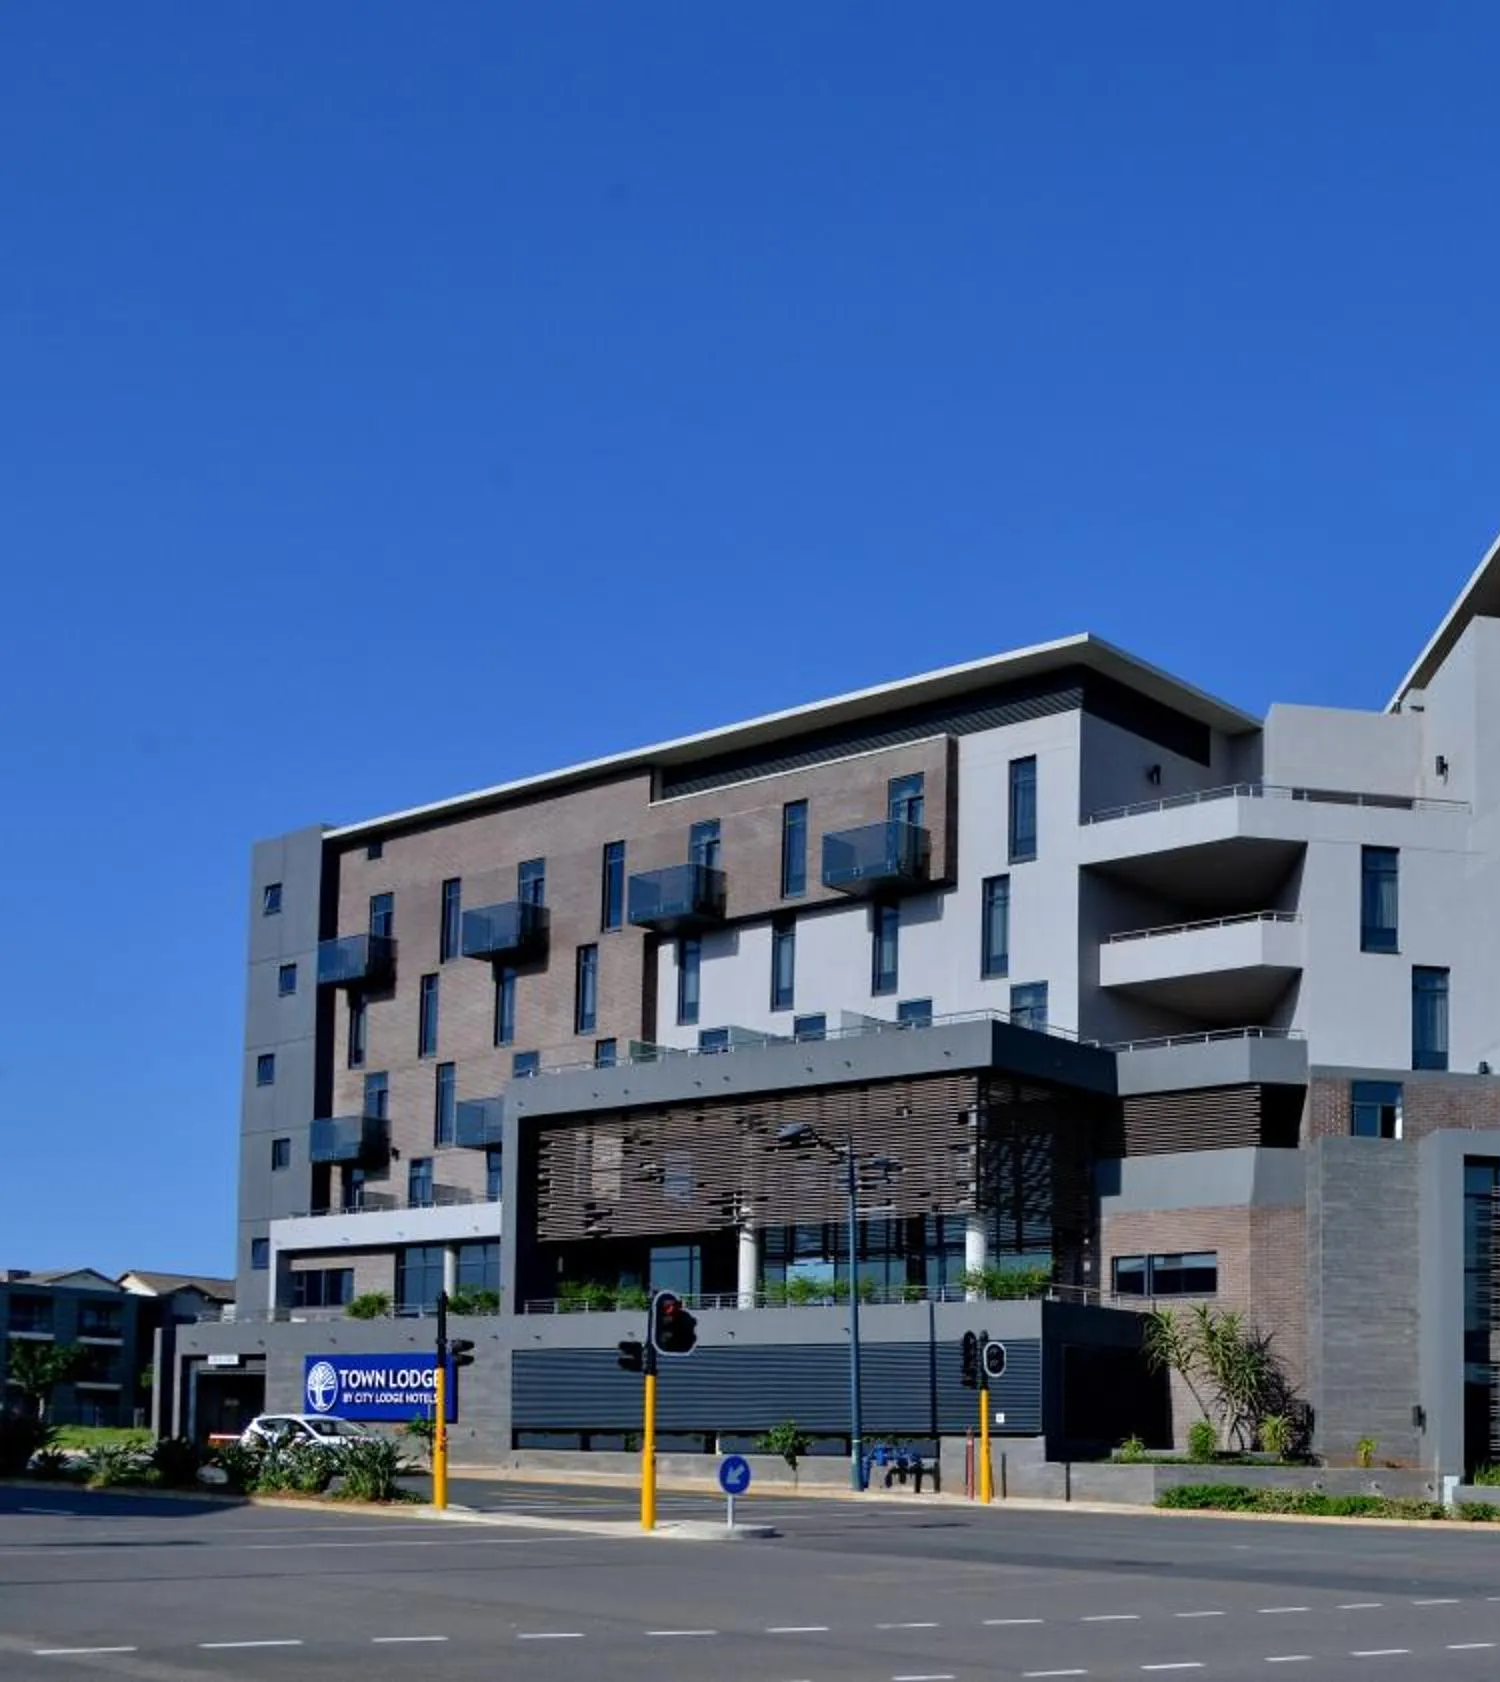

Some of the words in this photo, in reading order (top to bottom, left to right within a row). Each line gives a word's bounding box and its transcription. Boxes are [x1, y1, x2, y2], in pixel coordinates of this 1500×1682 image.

[339, 1369, 386, 1388] TOWN
[343, 1392, 353, 1404] BY
[354, 1392, 374, 1404] CITY
[375, 1392, 404, 1404] LODGE
